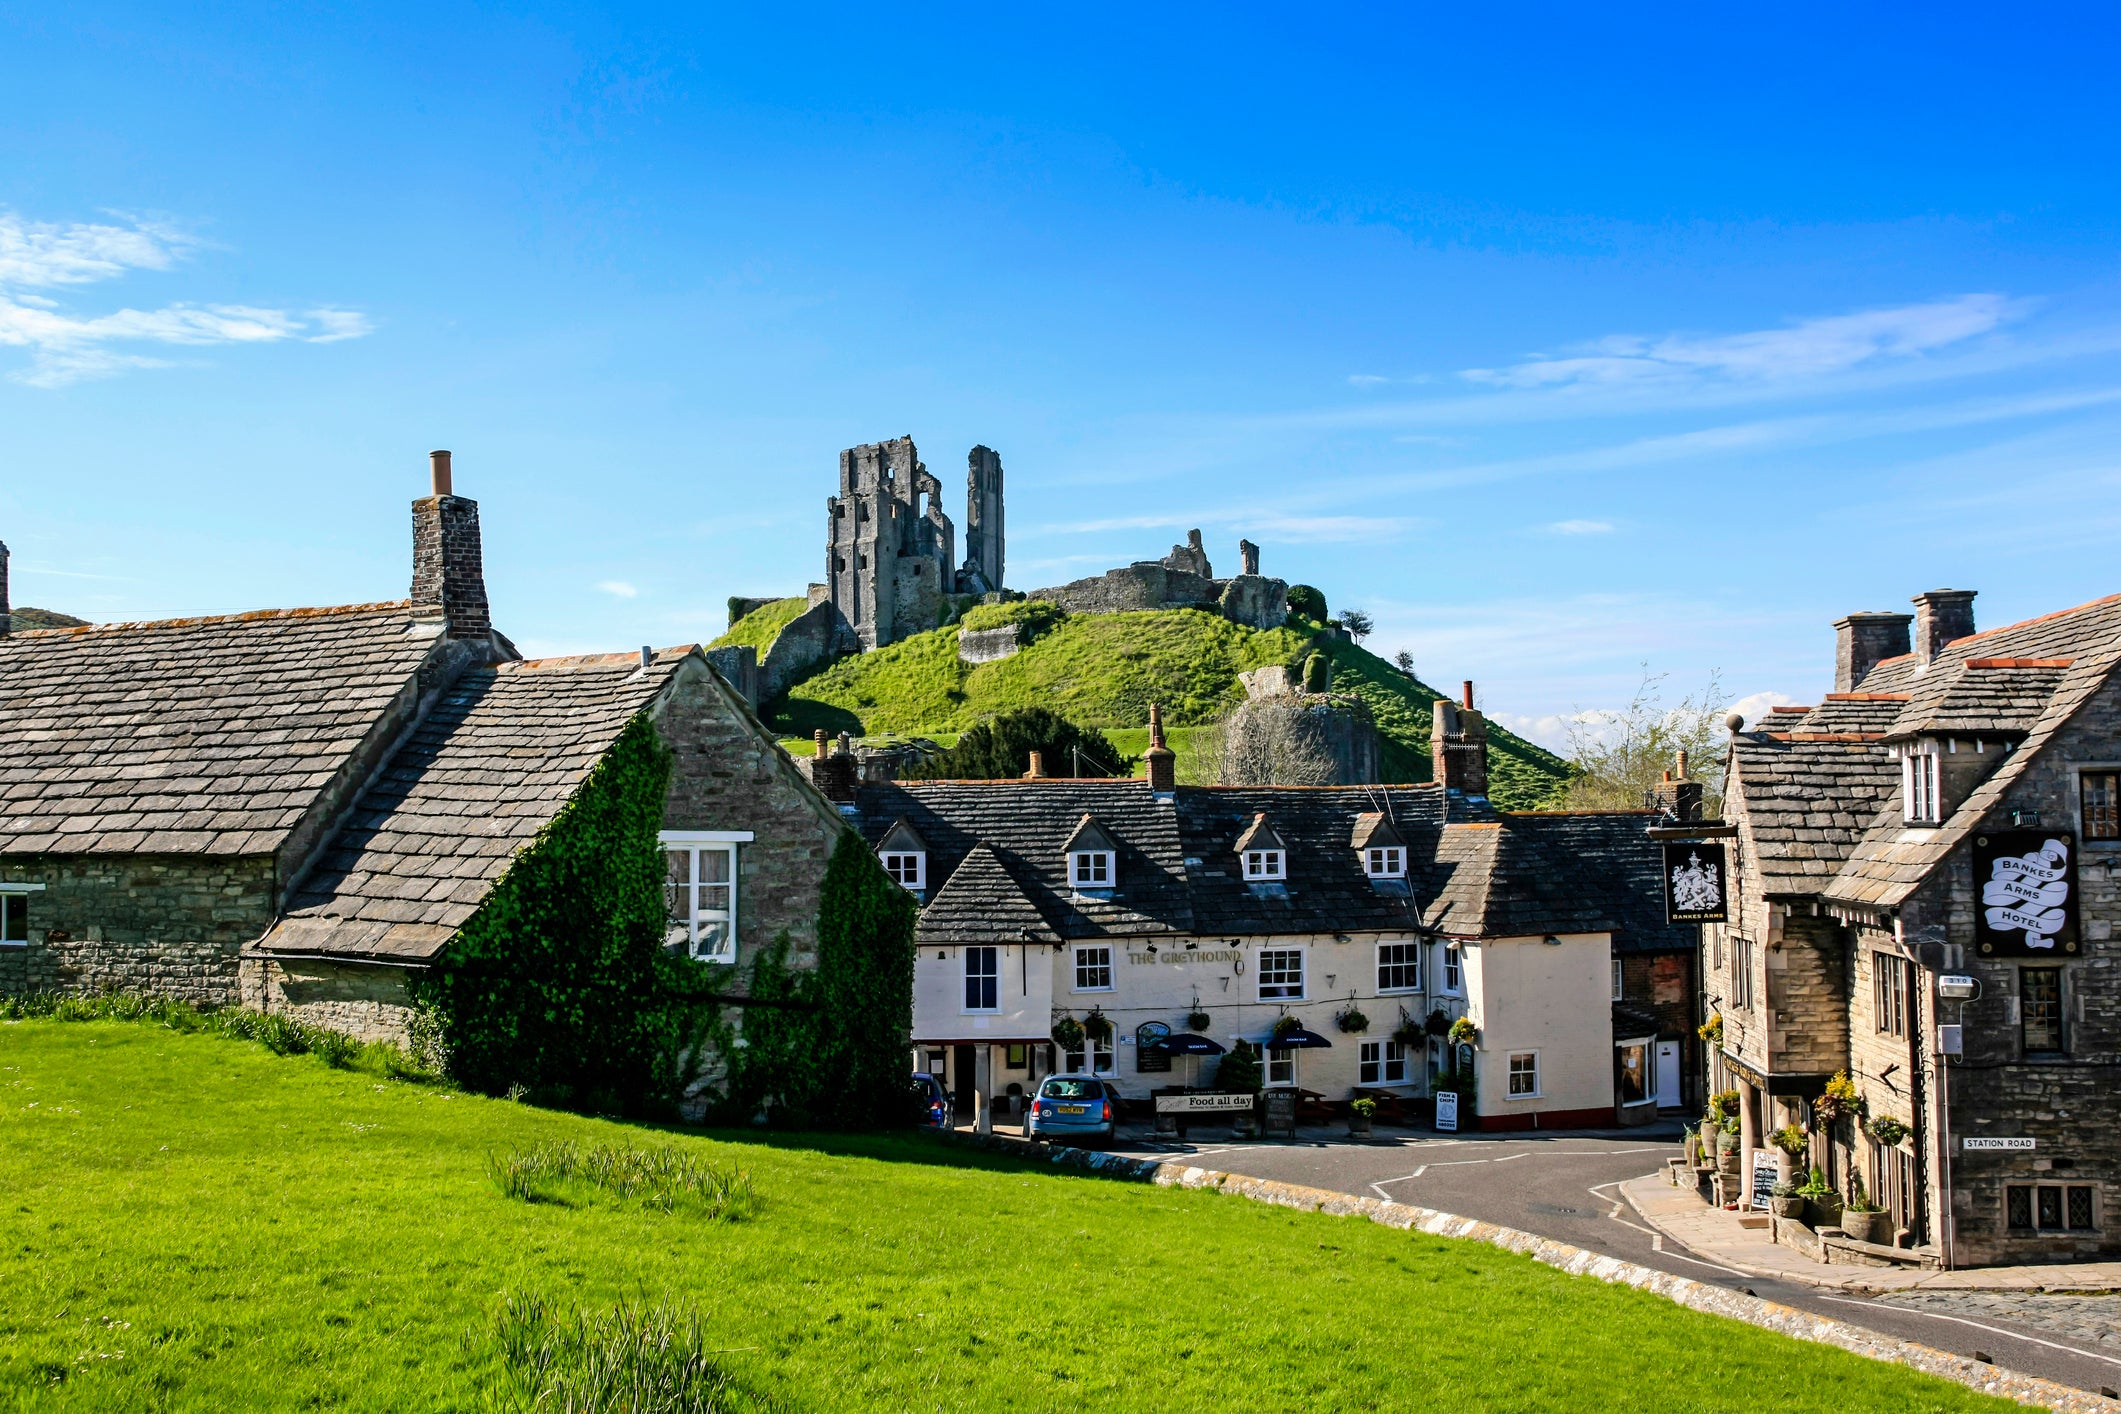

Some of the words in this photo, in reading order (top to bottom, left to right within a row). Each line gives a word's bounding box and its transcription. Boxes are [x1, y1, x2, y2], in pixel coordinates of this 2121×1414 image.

[2002, 860, 2054, 878] BANKES
[2003, 883, 2040, 900] ARMS
[2001, 911, 2042, 929] HOTEL
[1127, 953, 1156, 965] THE
[1160, 950, 1241, 964] GREYHOUND
[1189, 1096, 1214, 1106] Food
[1217, 1096, 1230, 1105] all
[1233, 1095, 1252, 1107] day
[1967, 1139, 2004, 1147] STATION
[2008, 1139, 2032, 1147] ROAD
